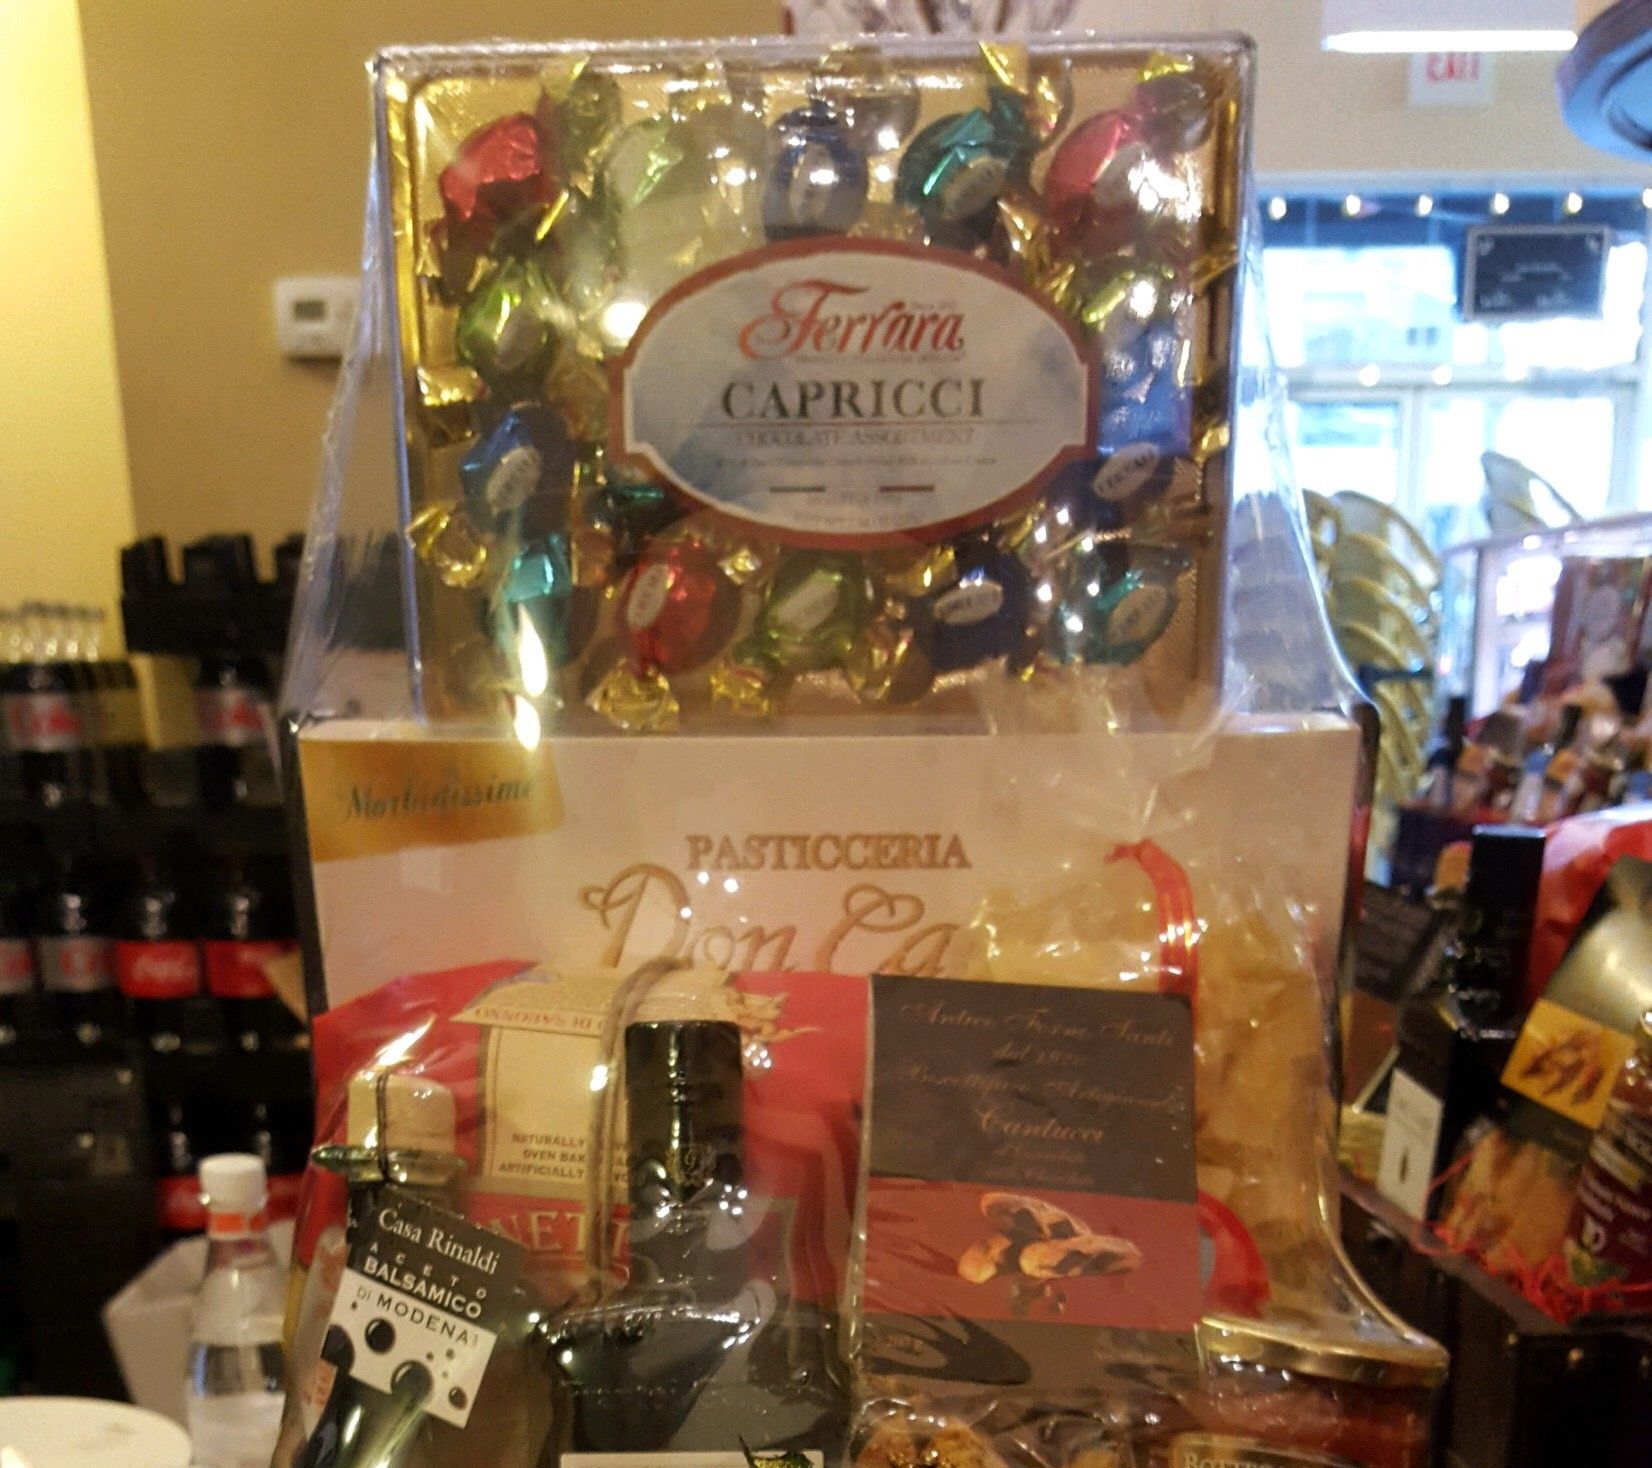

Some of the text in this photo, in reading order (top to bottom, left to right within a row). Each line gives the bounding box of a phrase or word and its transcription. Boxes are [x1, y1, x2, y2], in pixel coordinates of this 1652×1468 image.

[739, 279, 966, 360] Ferrara
[720, 377, 986, 421] CAPRICCI
[686, 833, 973, 870] PASTICCERIA
[499, 1161, 585, 1179] ARTIFICIALLY
[379, 1207, 501, 1276] Casa Rinaldi
[362, 1256, 483, 1320] BALSAMICO
[376, 1293, 469, 1345] MODENA
